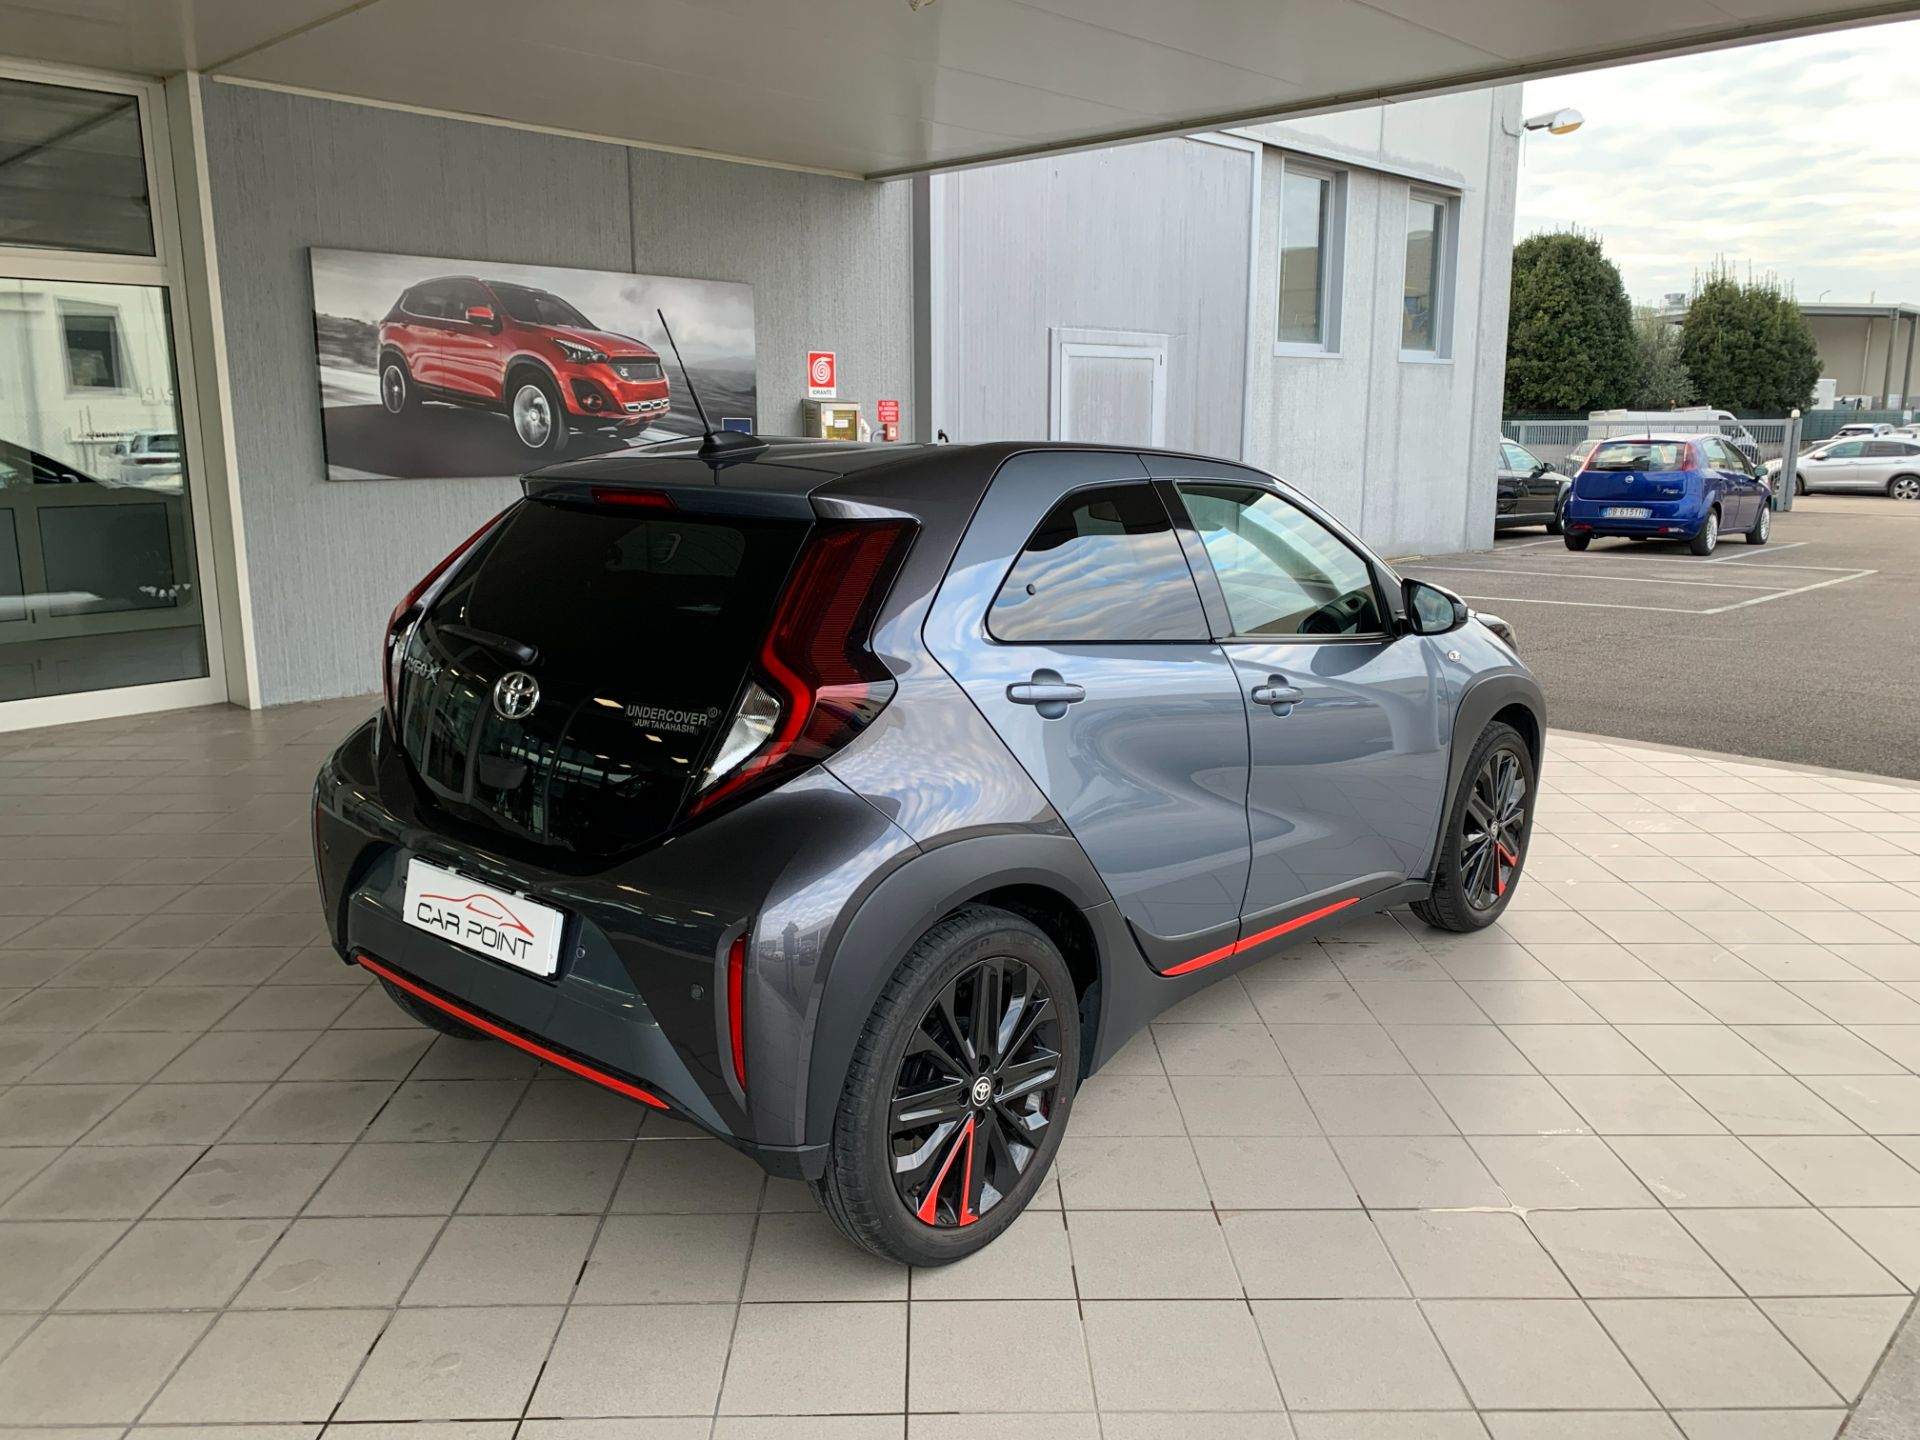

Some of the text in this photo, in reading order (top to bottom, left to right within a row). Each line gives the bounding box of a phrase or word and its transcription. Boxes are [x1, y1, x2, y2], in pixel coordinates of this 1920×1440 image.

[627, 704, 708, 726] UNDERCOVER
[417, 903, 533, 959] CAR POINT
